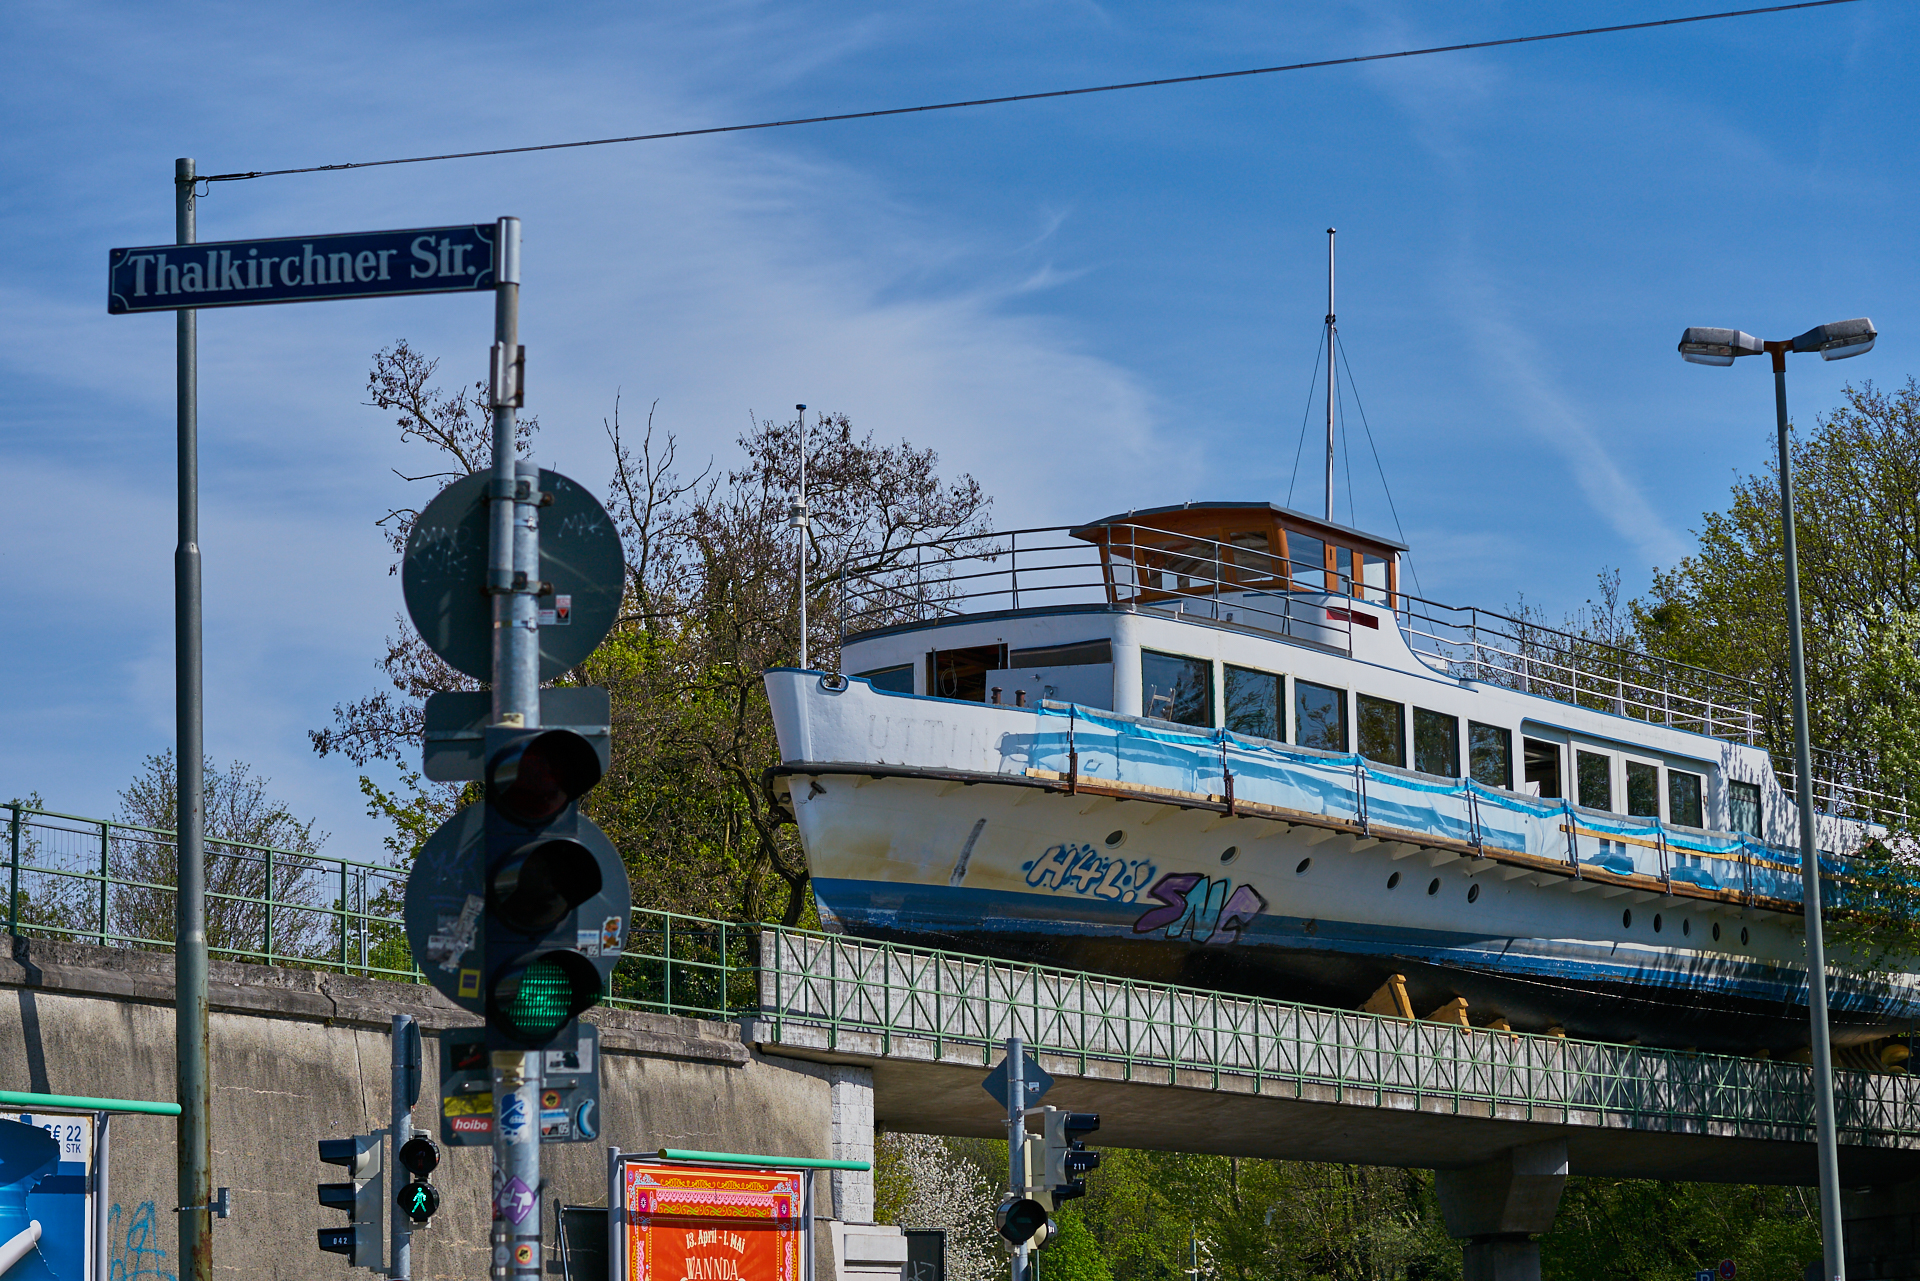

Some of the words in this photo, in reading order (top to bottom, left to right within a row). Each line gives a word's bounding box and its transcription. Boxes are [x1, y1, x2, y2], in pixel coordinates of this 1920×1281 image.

[128, 244, 397, 298] Thalkirchner
[410, 235, 477, 278] Str.
[66, 1125, 81, 1142] 22
[455, 1119, 488, 1130] hoibe
[66, 1143, 81, 1153] STK
[698, 1228, 717, 1247] April
[685, 1256, 738, 1280] WANNDA
